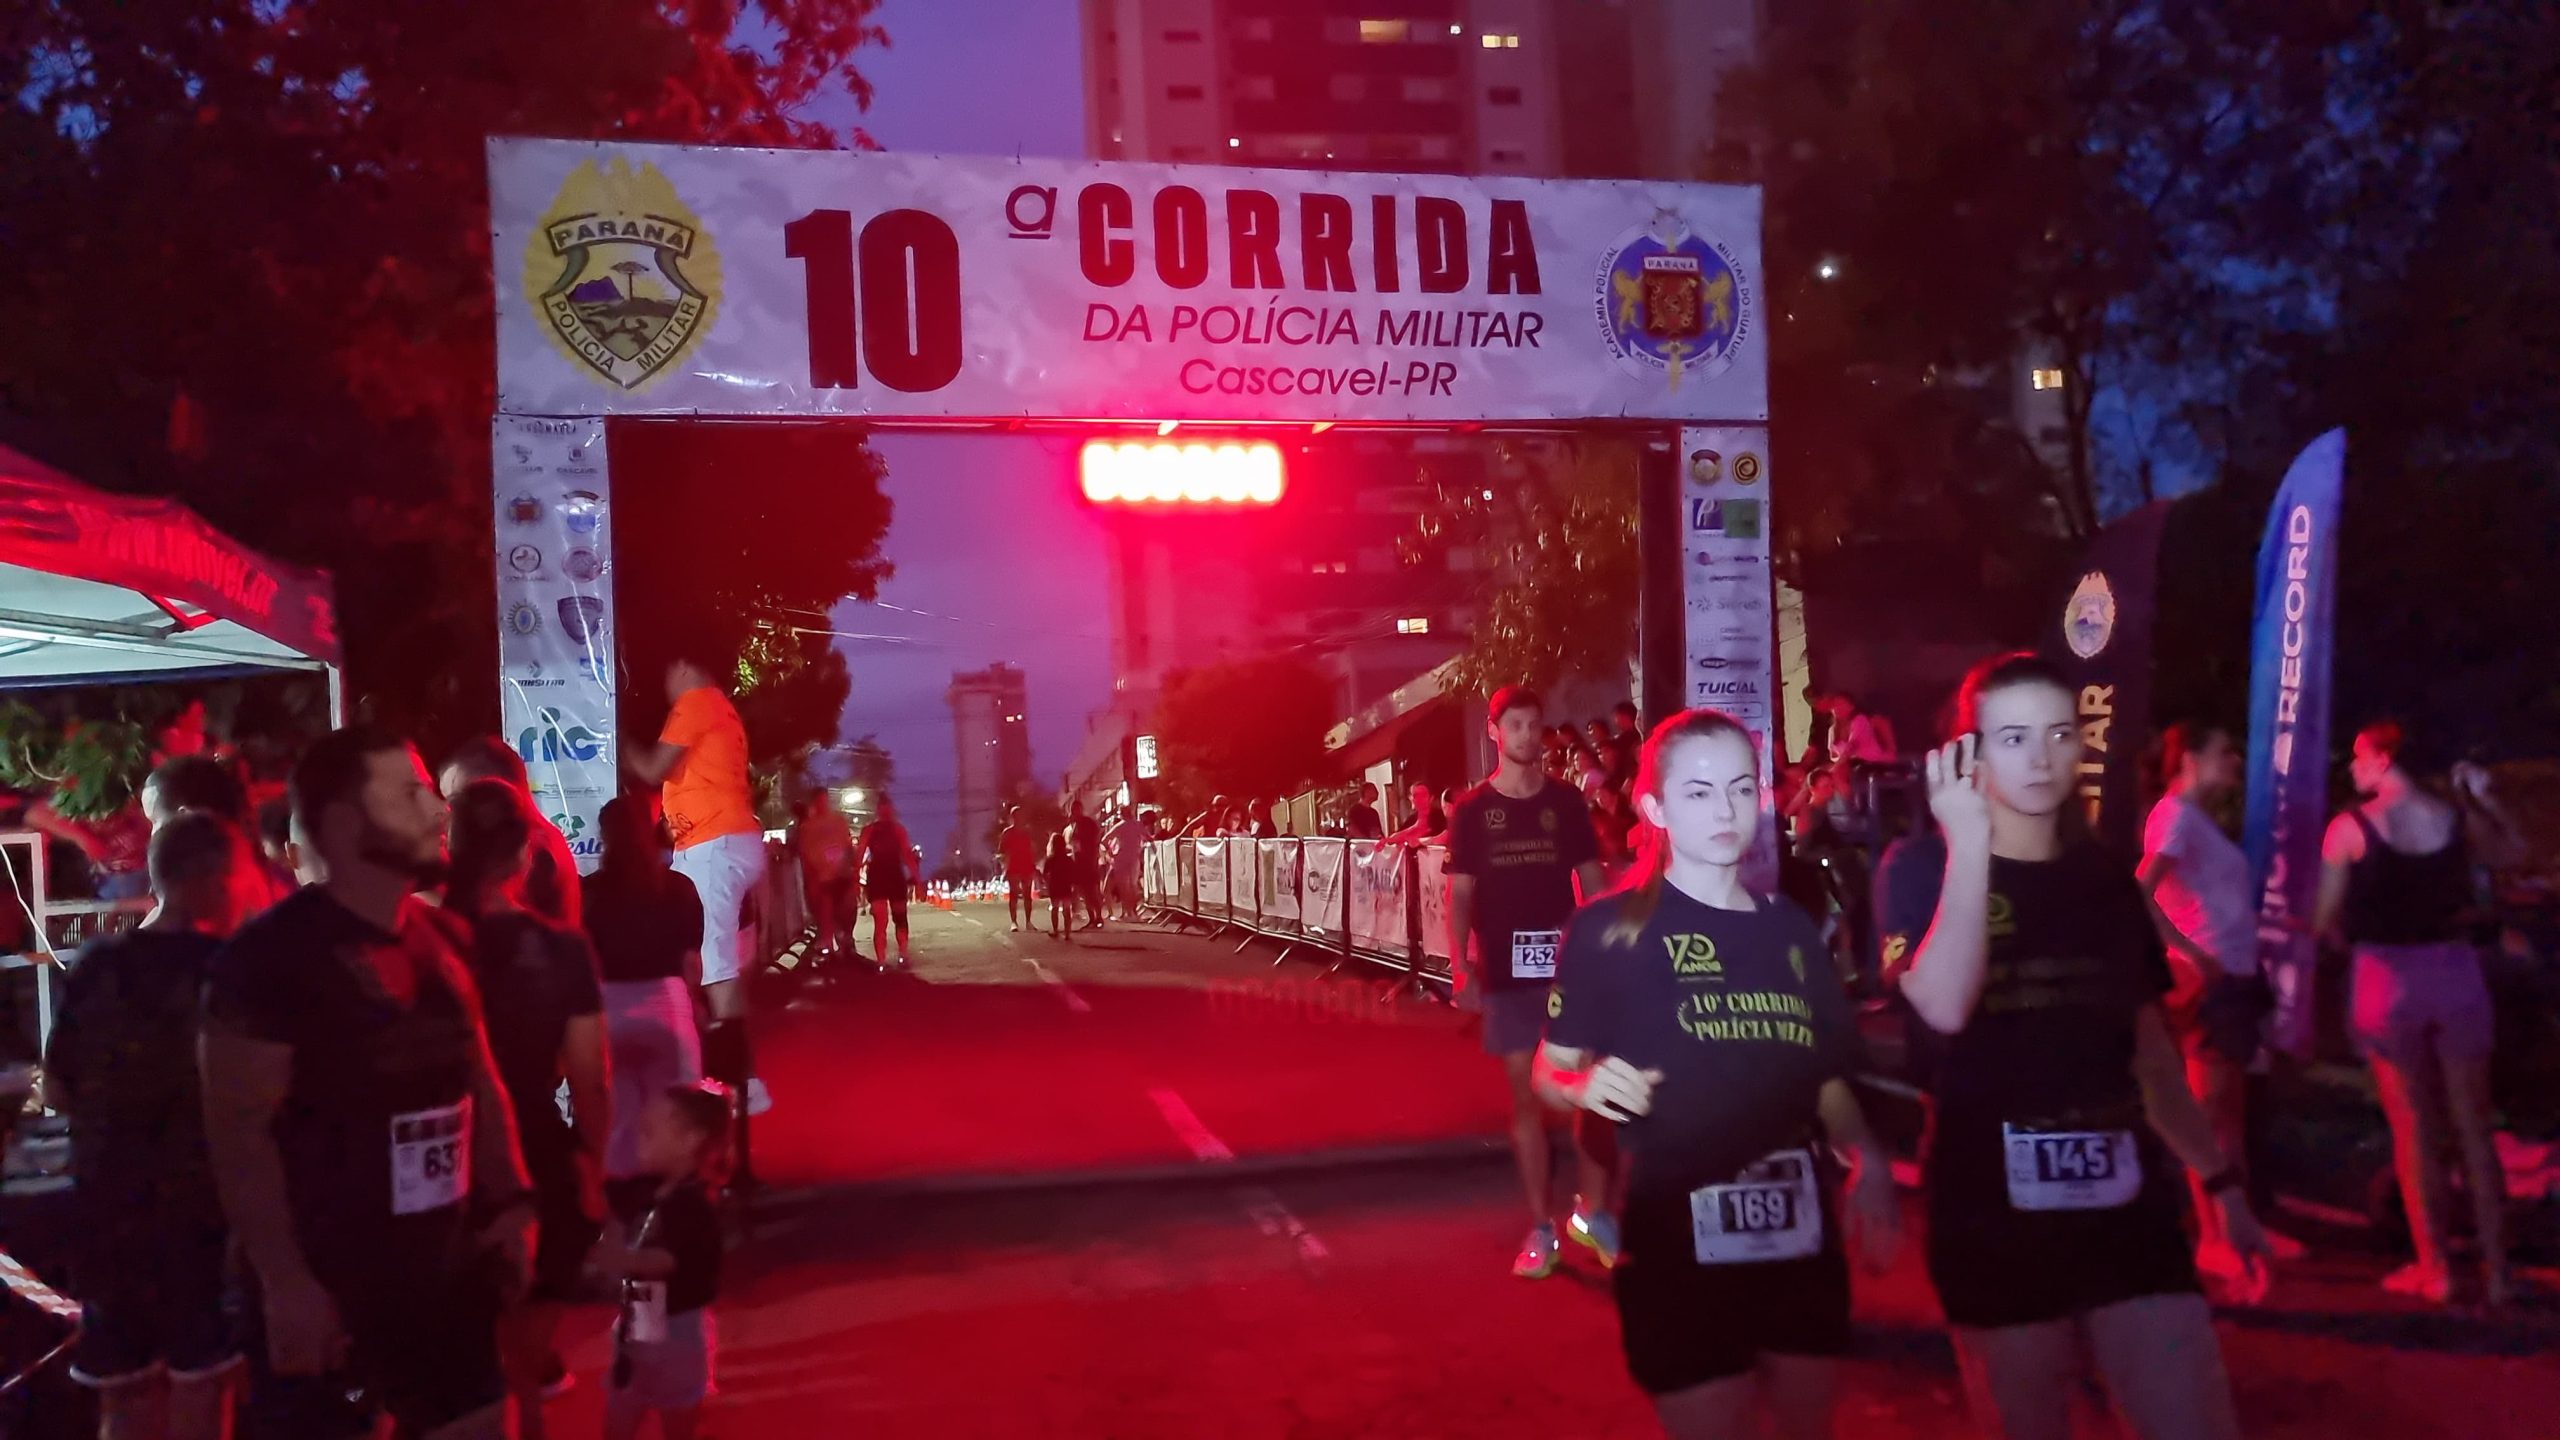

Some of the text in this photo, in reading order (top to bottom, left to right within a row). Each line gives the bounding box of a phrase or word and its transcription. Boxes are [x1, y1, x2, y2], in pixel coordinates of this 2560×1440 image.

[554, 220, 684, 249] PARANÁ
[1595, 246, 1620, 295] POLICIAL
[1716, 242, 1747, 284] MILITAR
[784, 208, 963, 393] 10
[1078, 182, 1542, 296] CORRIDA
[1739, 287, 1751, 306] DO
[635, 302, 697, 372] MILITAR
[1082, 295, 1545, 349] DA POLÍCIA MILITAR
[1594, 297, 1625, 360] ACADEMIA
[1179, 358, 1459, 397] Cascavel-PR
[2277, 504, 2312, 725] RECORD
[519, 707, 608, 763] ric
[1524, 947, 1555, 966] 252
[2042, 1137, 2111, 1180] 145
[1728, 1190, 1787, 1230] 169
